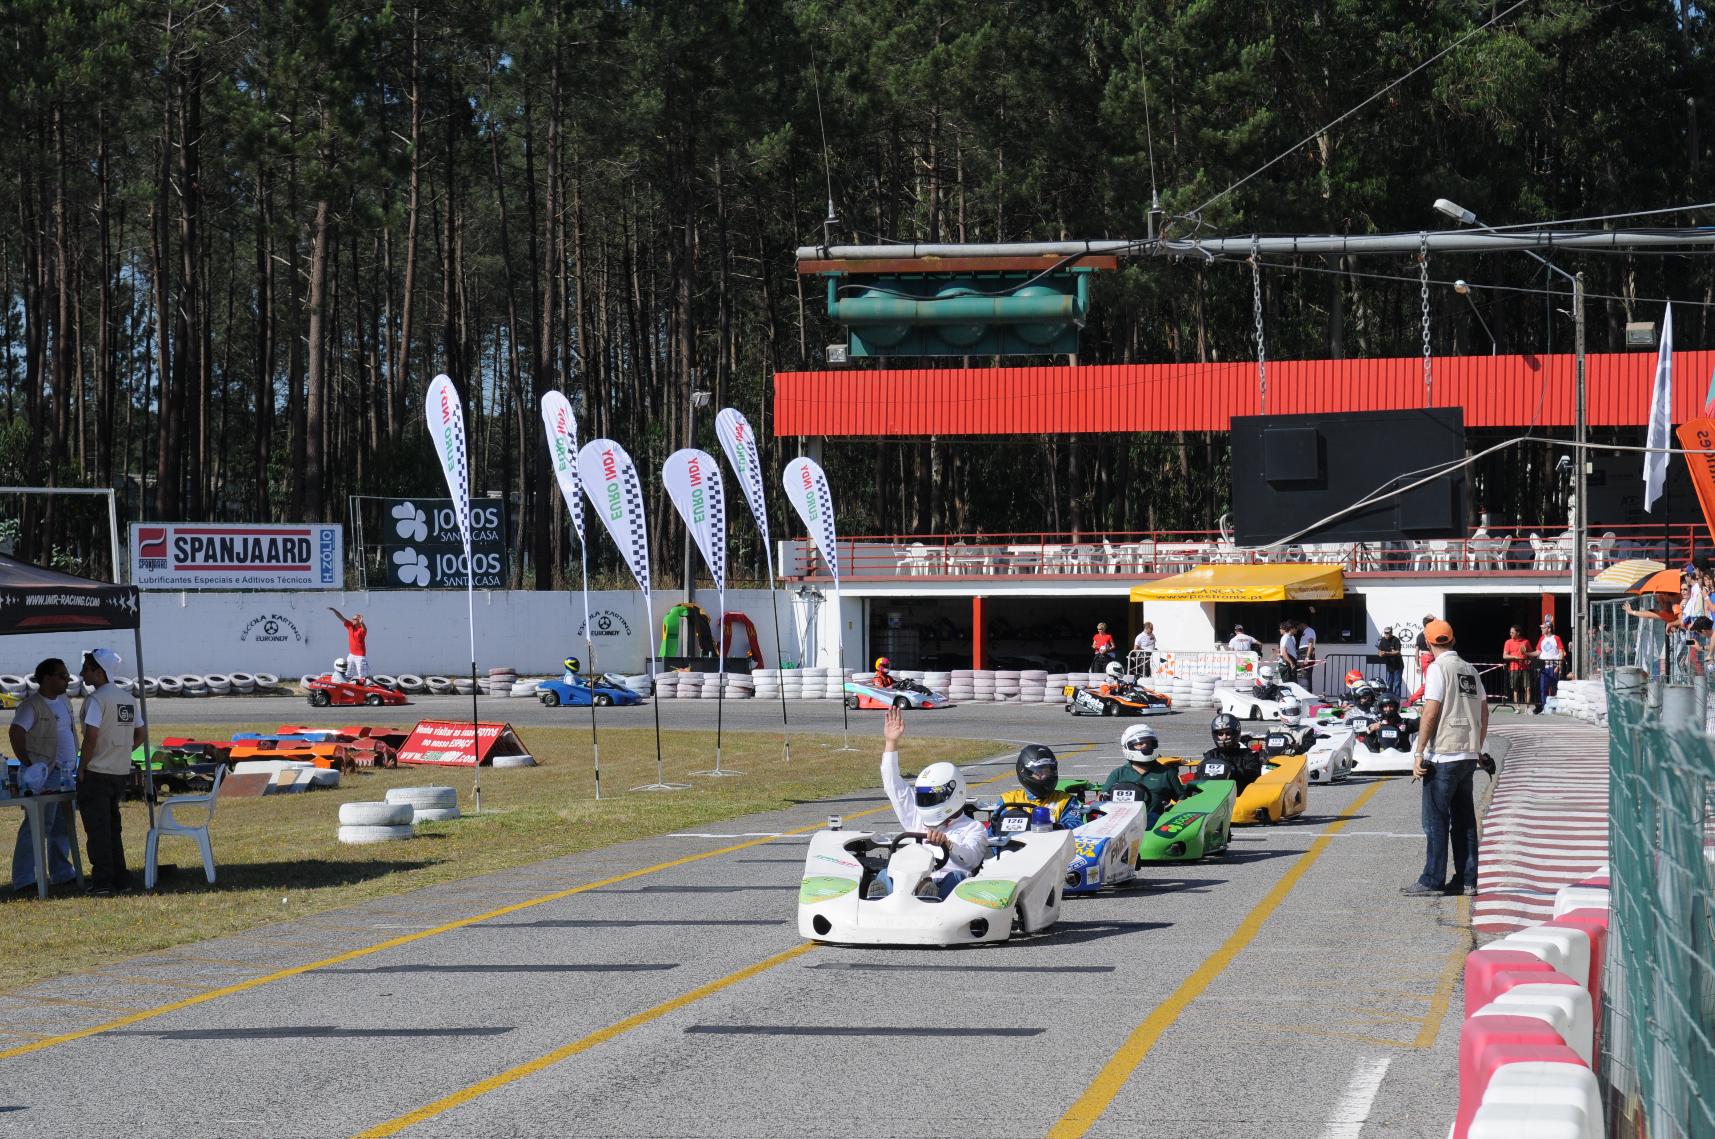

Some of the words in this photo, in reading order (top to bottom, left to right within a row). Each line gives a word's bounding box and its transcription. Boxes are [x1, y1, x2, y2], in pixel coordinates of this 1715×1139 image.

[473, 530, 499, 541] CASA
[173, 536, 312, 564] SPANJAARD
[138, 576, 192, 584] Lubrificantes
[194, 576, 233, 586] Especiais
[242, 575, 275, 584] Aditivos
[277, 575, 313, 584] Técnicos
[474, 575, 501, 586] CASA
